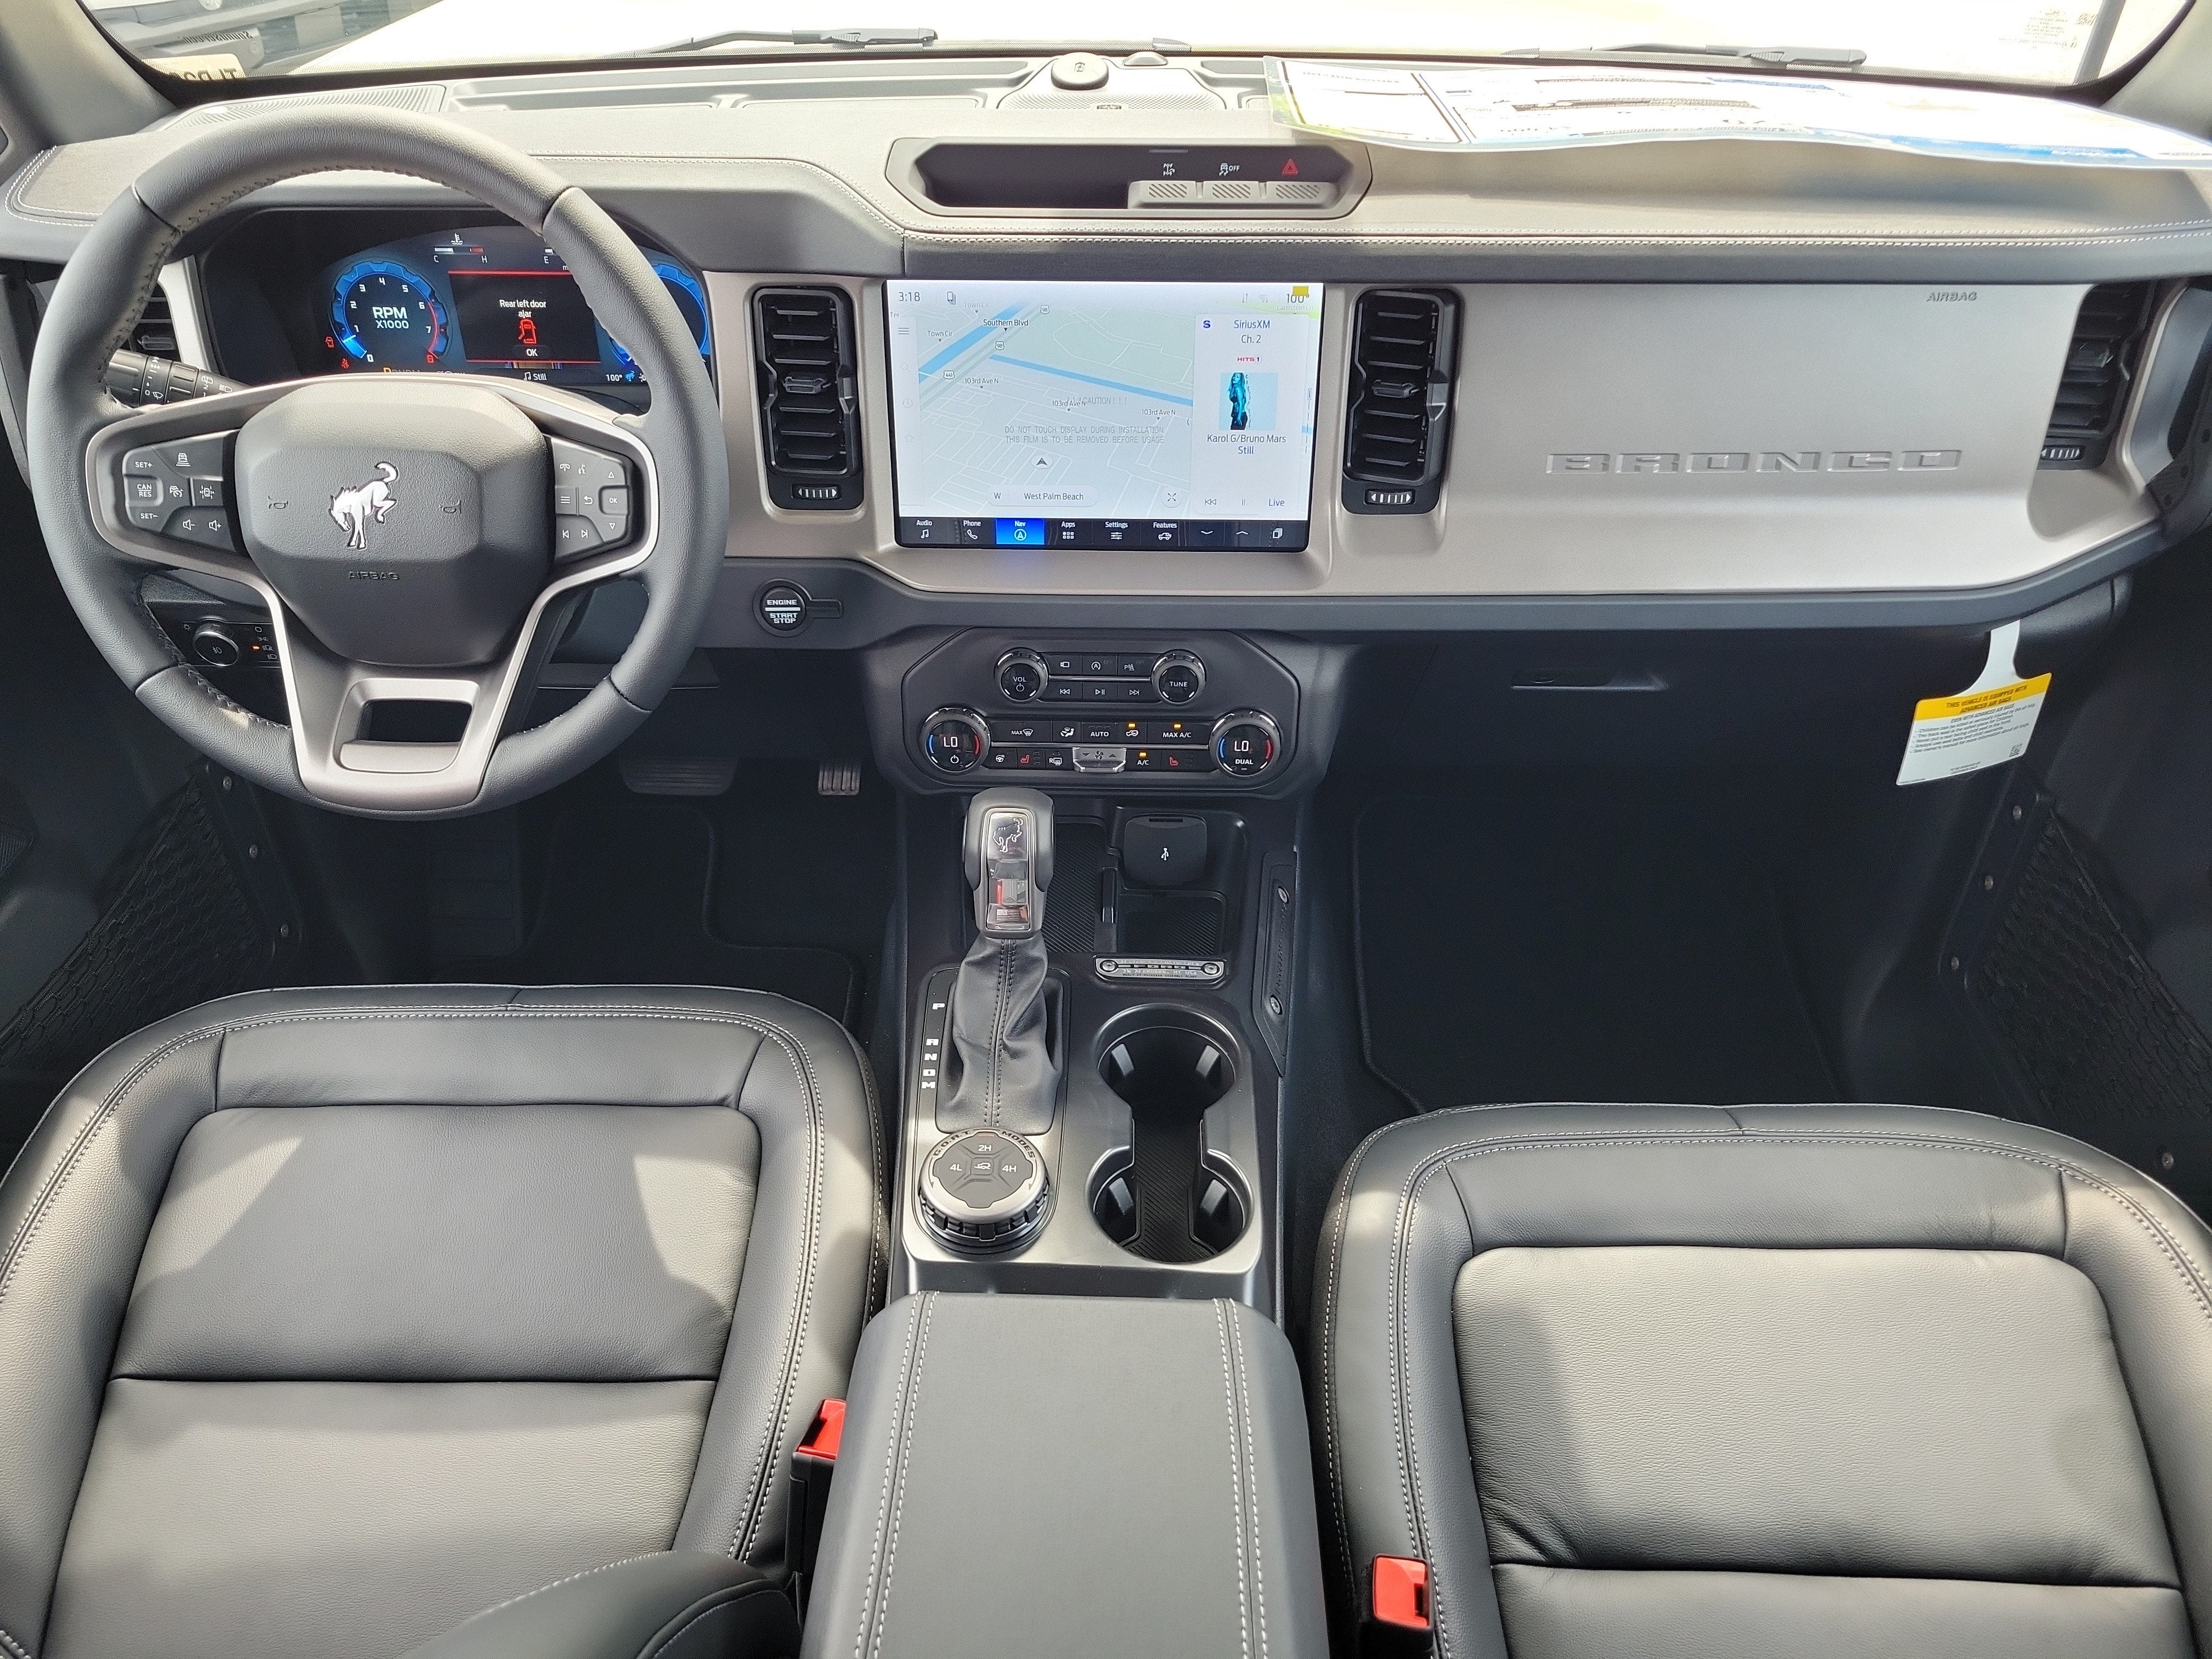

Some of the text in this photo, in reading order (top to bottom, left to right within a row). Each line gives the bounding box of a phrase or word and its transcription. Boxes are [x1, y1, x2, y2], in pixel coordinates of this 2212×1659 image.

[379, 277, 386, 285] 4
[898, 291, 921, 302] 3:18
[1926, 291, 1977, 302] AIRBAG
[499, 299, 546, 308] Rear left door
[372, 306, 408, 319] RPM
[375, 320, 409, 329] X1000
[1234, 319, 1270, 329] SiriusXM
[1241, 335, 1261, 343] Ch. 2
[533, 373, 547, 381] Still
[1207, 434, 1286, 443] Karol G/Bruno Mars
[1238, 445, 1254, 454] Still
[1547, 449, 1962, 475] BRONCO
[1043, 493, 1060, 501] Palm
[1268, 498, 1285, 506] Live
[348, 571, 400, 580] AIRBAG
[944, 736, 958, 747] LO
[1234, 741, 1249, 752] LO
[1001, 1131, 1036, 1159] MODES
